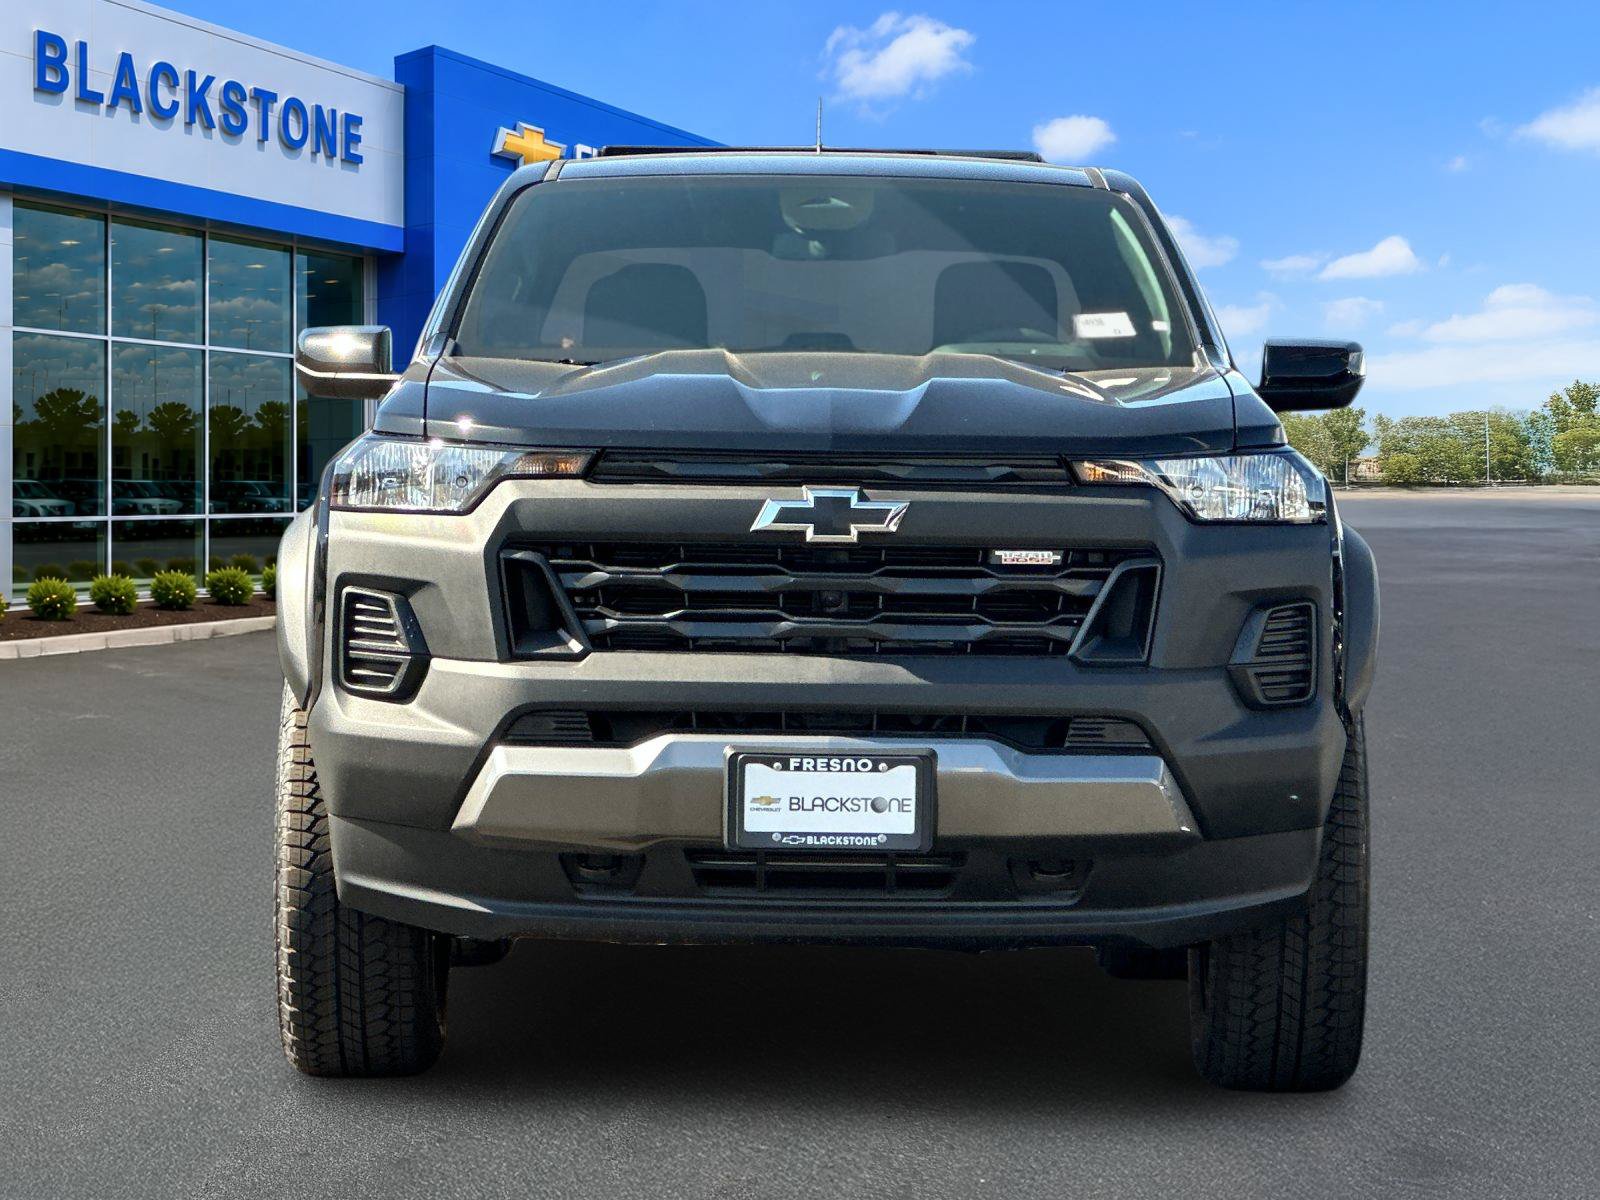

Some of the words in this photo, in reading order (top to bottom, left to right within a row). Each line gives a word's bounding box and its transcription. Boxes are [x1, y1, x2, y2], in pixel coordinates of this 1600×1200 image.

[34, 29, 364, 165] BLACKSTONE
[789, 757, 873, 772] FRESNO
[789, 796, 912, 814] BLACKSTONE
[806, 835, 878, 846] BLACKSTONE
